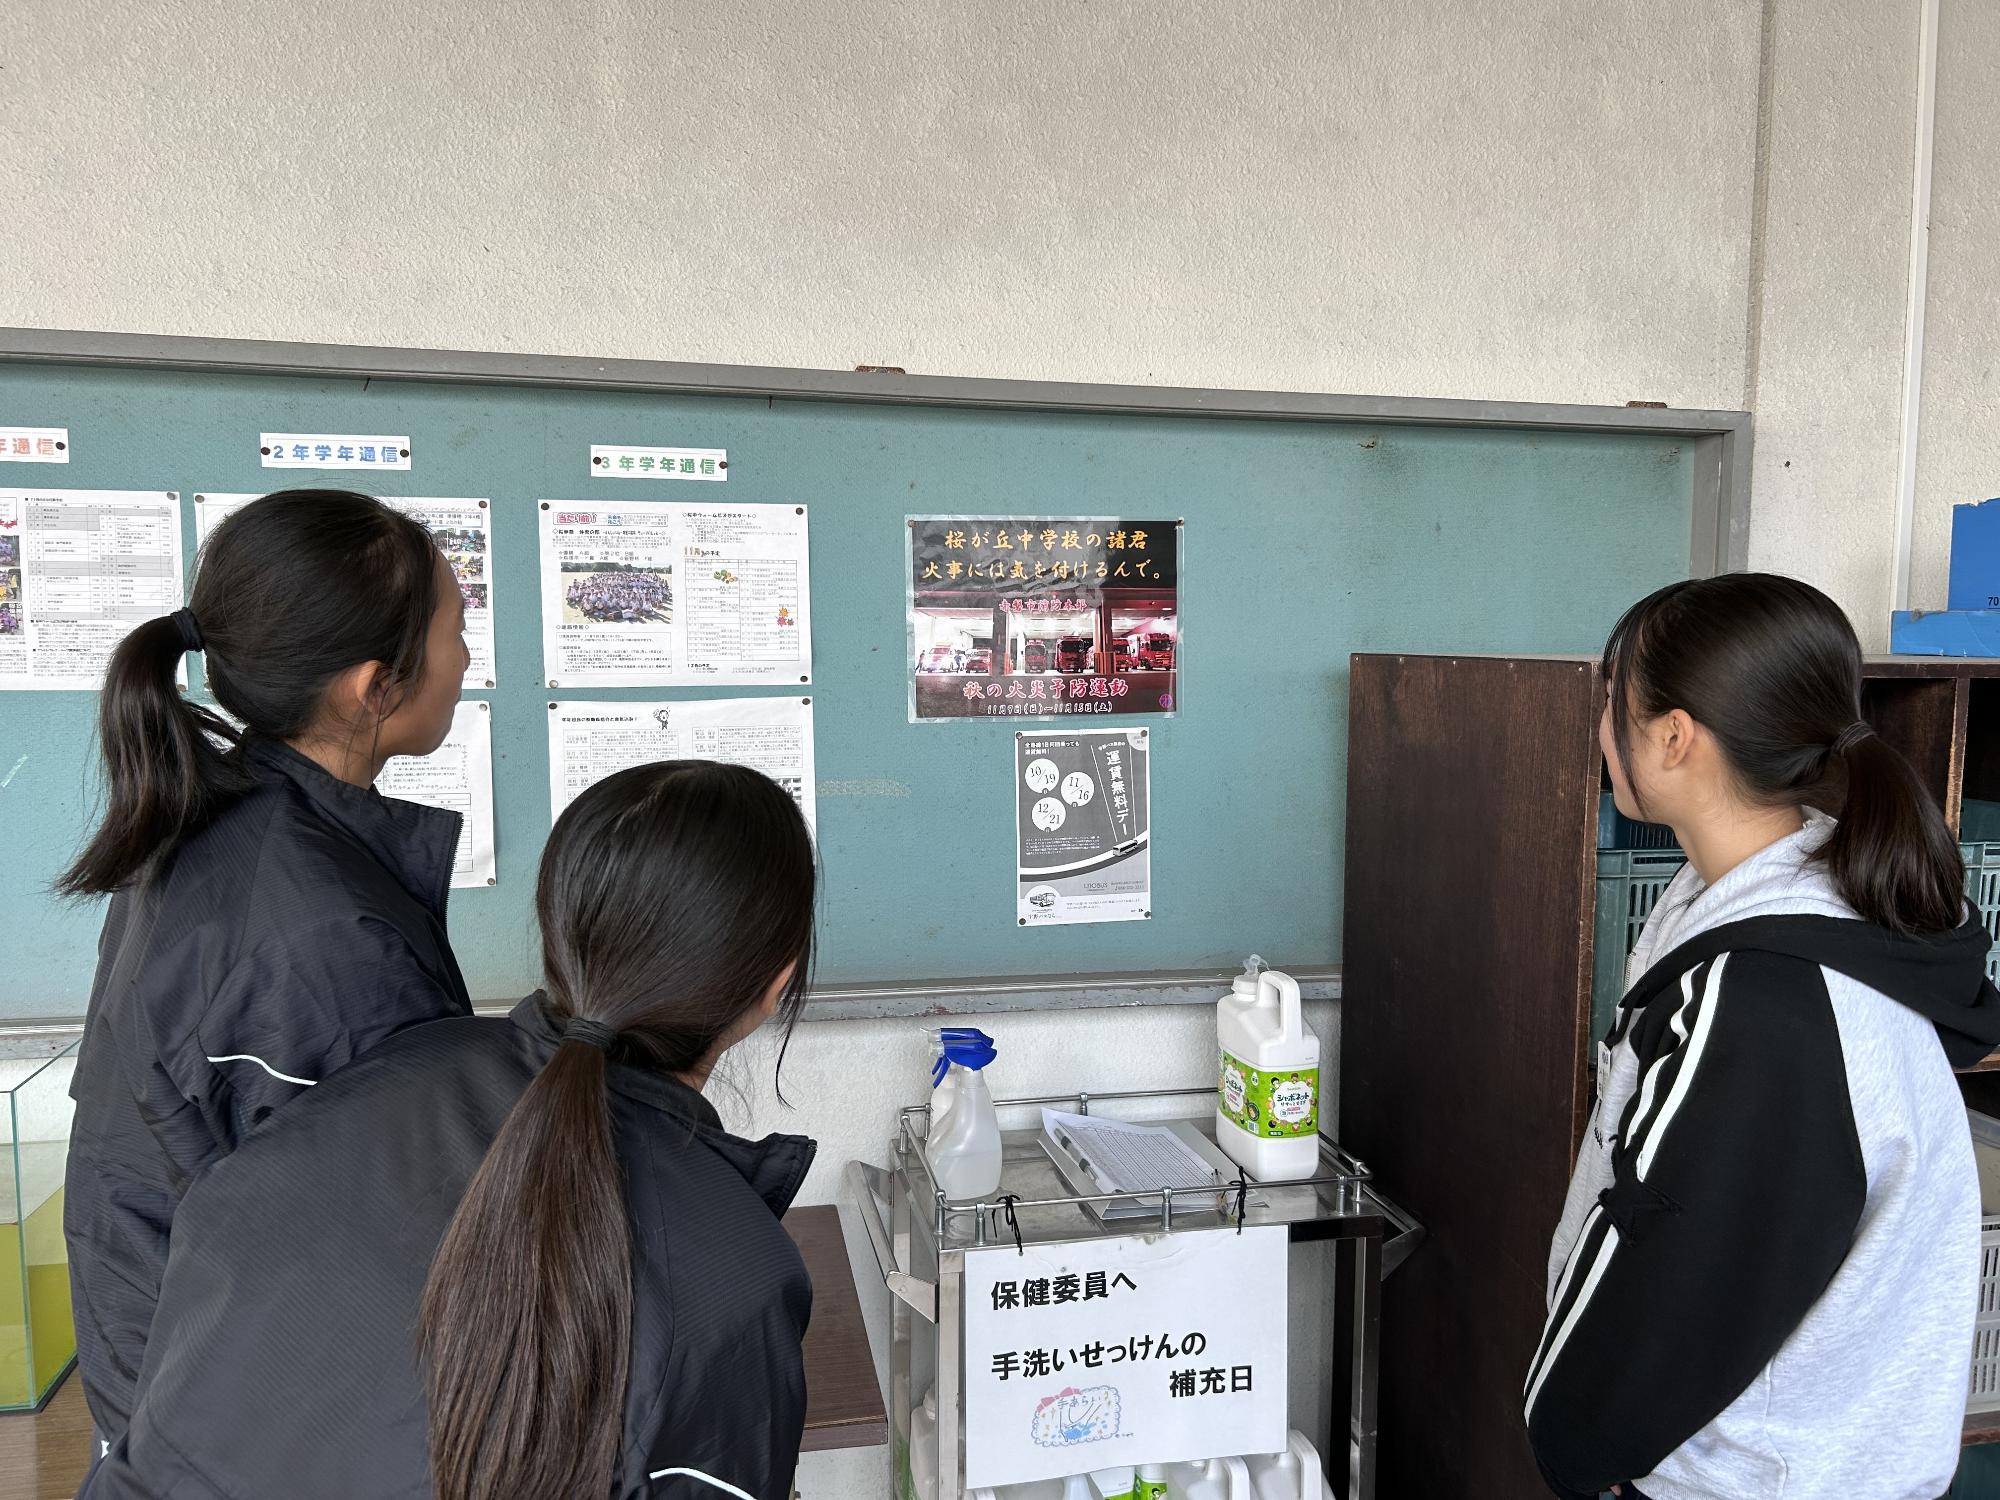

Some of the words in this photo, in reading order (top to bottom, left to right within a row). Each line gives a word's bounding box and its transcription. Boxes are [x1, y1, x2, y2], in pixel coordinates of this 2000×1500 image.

[273, 443, 399, 463] 2年学年通信
[600, 455, 716, 475] 3年学年通信
[944, 529, 1149, 551] 桜が丘中学校の諸君
[921, 560, 1161, 581] 火事には気を付けるんで。
[962, 678, 1129, 700] 秋の火災予防運動
[1105, 749, 1129, 836] 運賃無料デー
[1277, 1092, 1309, 1102] シャボネット
[991, 1271, 1137, 1311] 保健委員へ
[992, 1330, 1207, 1381] 手洗いせっけんの
[1169, 1365, 1254, 1398] 補充日
